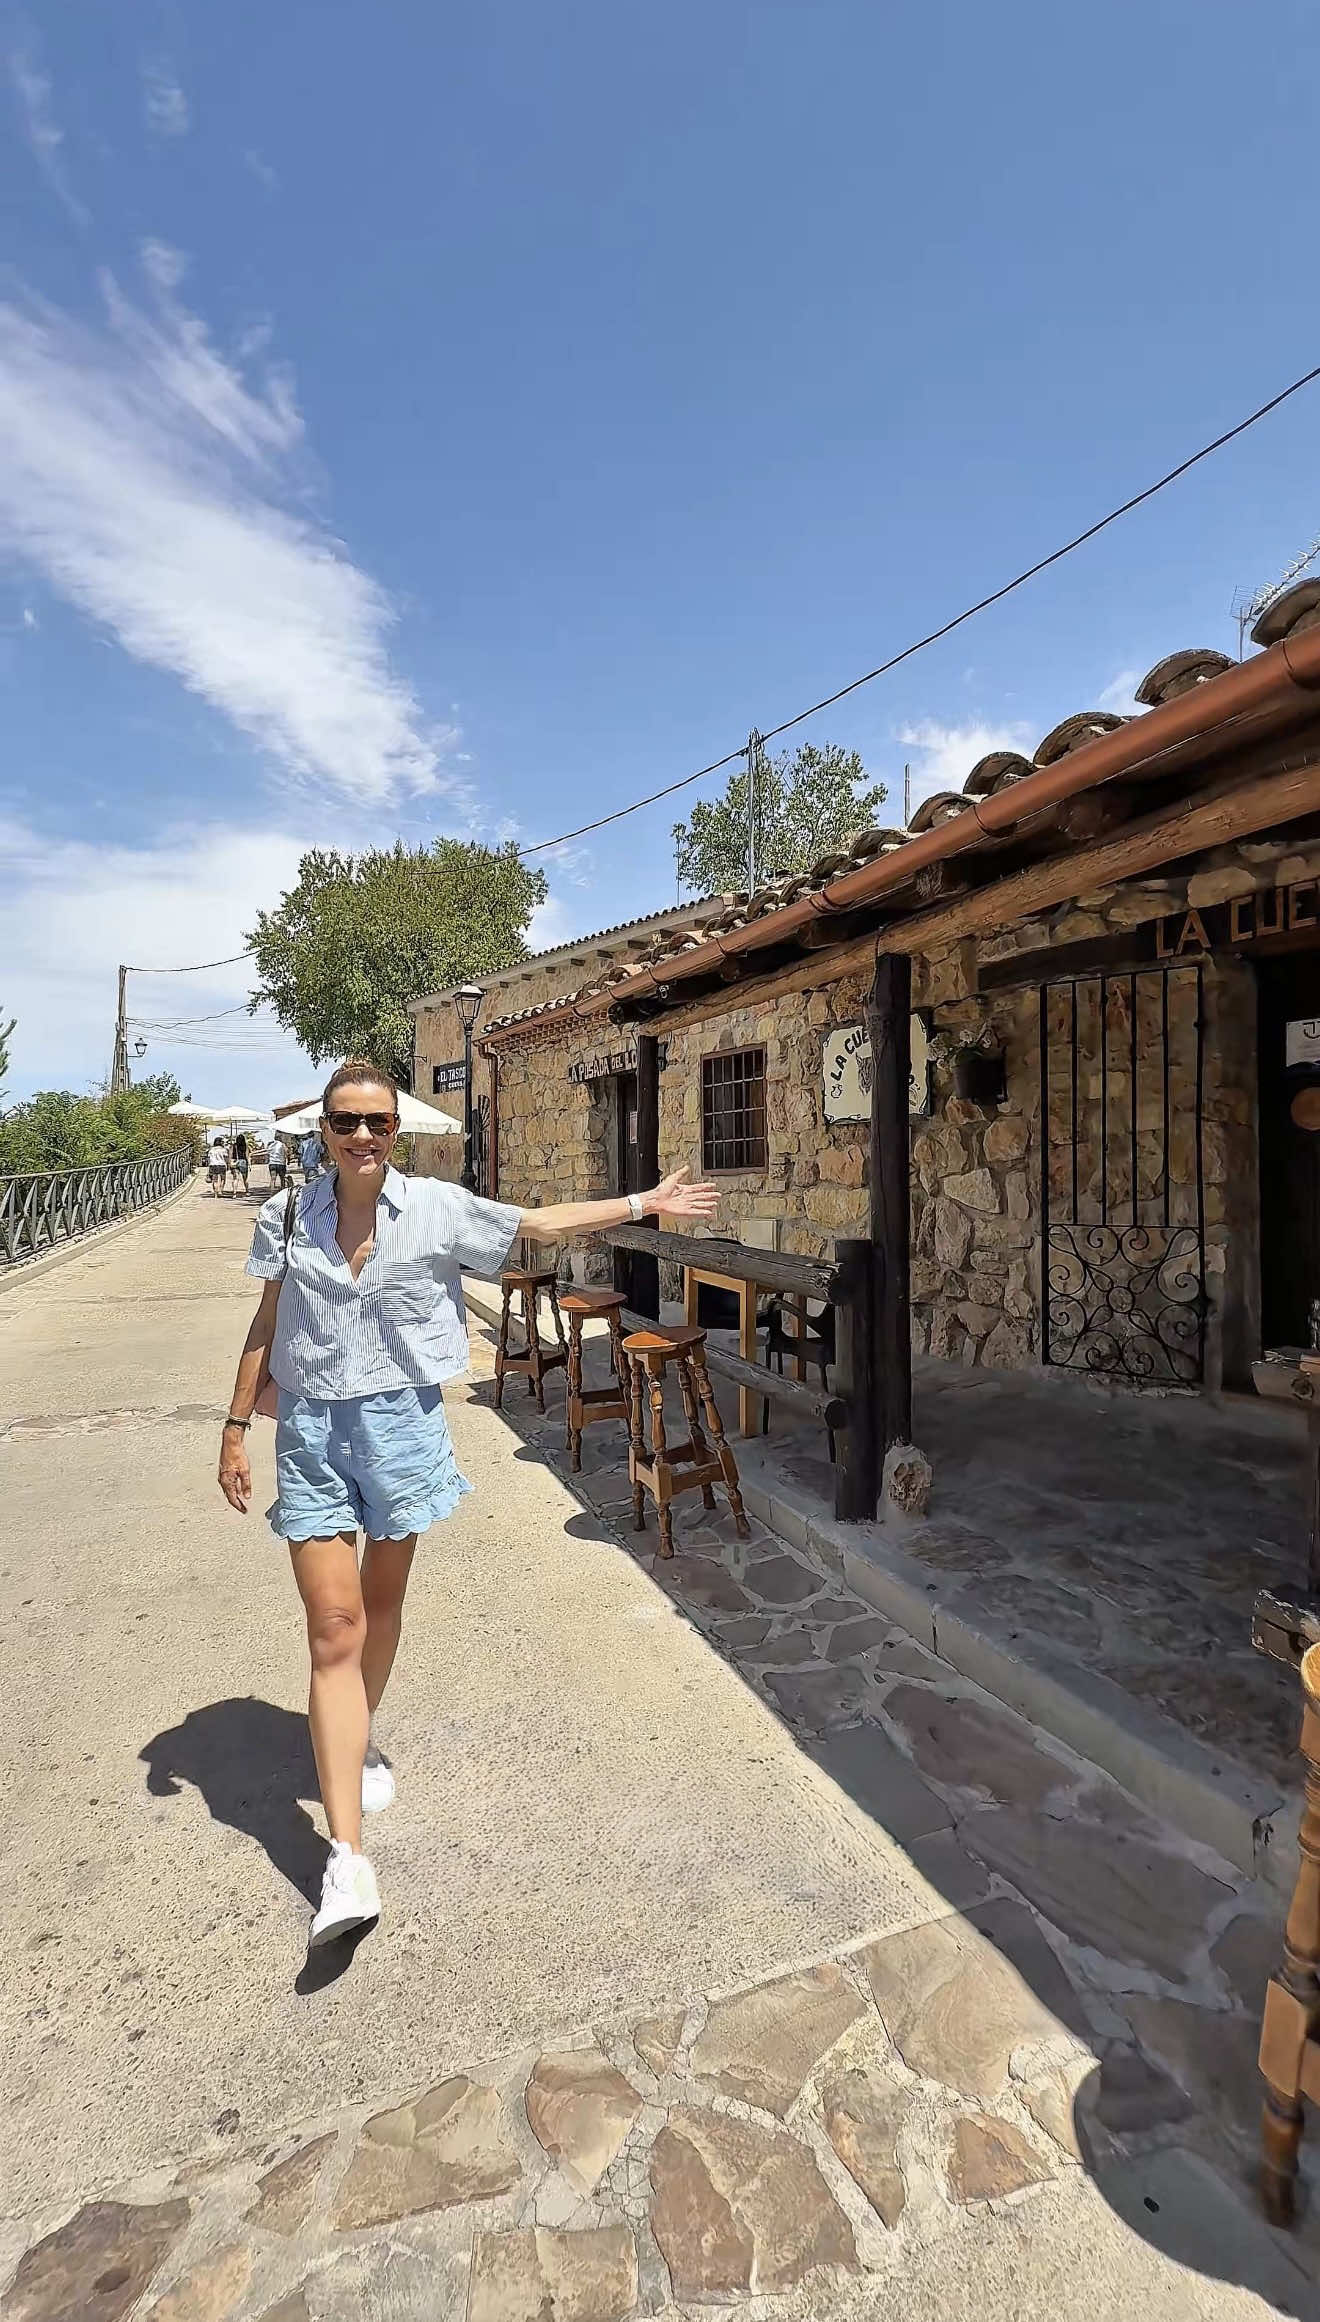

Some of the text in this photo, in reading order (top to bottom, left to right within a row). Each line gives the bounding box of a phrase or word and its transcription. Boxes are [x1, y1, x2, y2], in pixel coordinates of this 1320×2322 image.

[1156, 909, 1212, 959] LA
[578, 1057, 610, 1081] POSADA
[611, 1055, 624, 1070] DEL
[830, 1054, 848, 1081] LA
